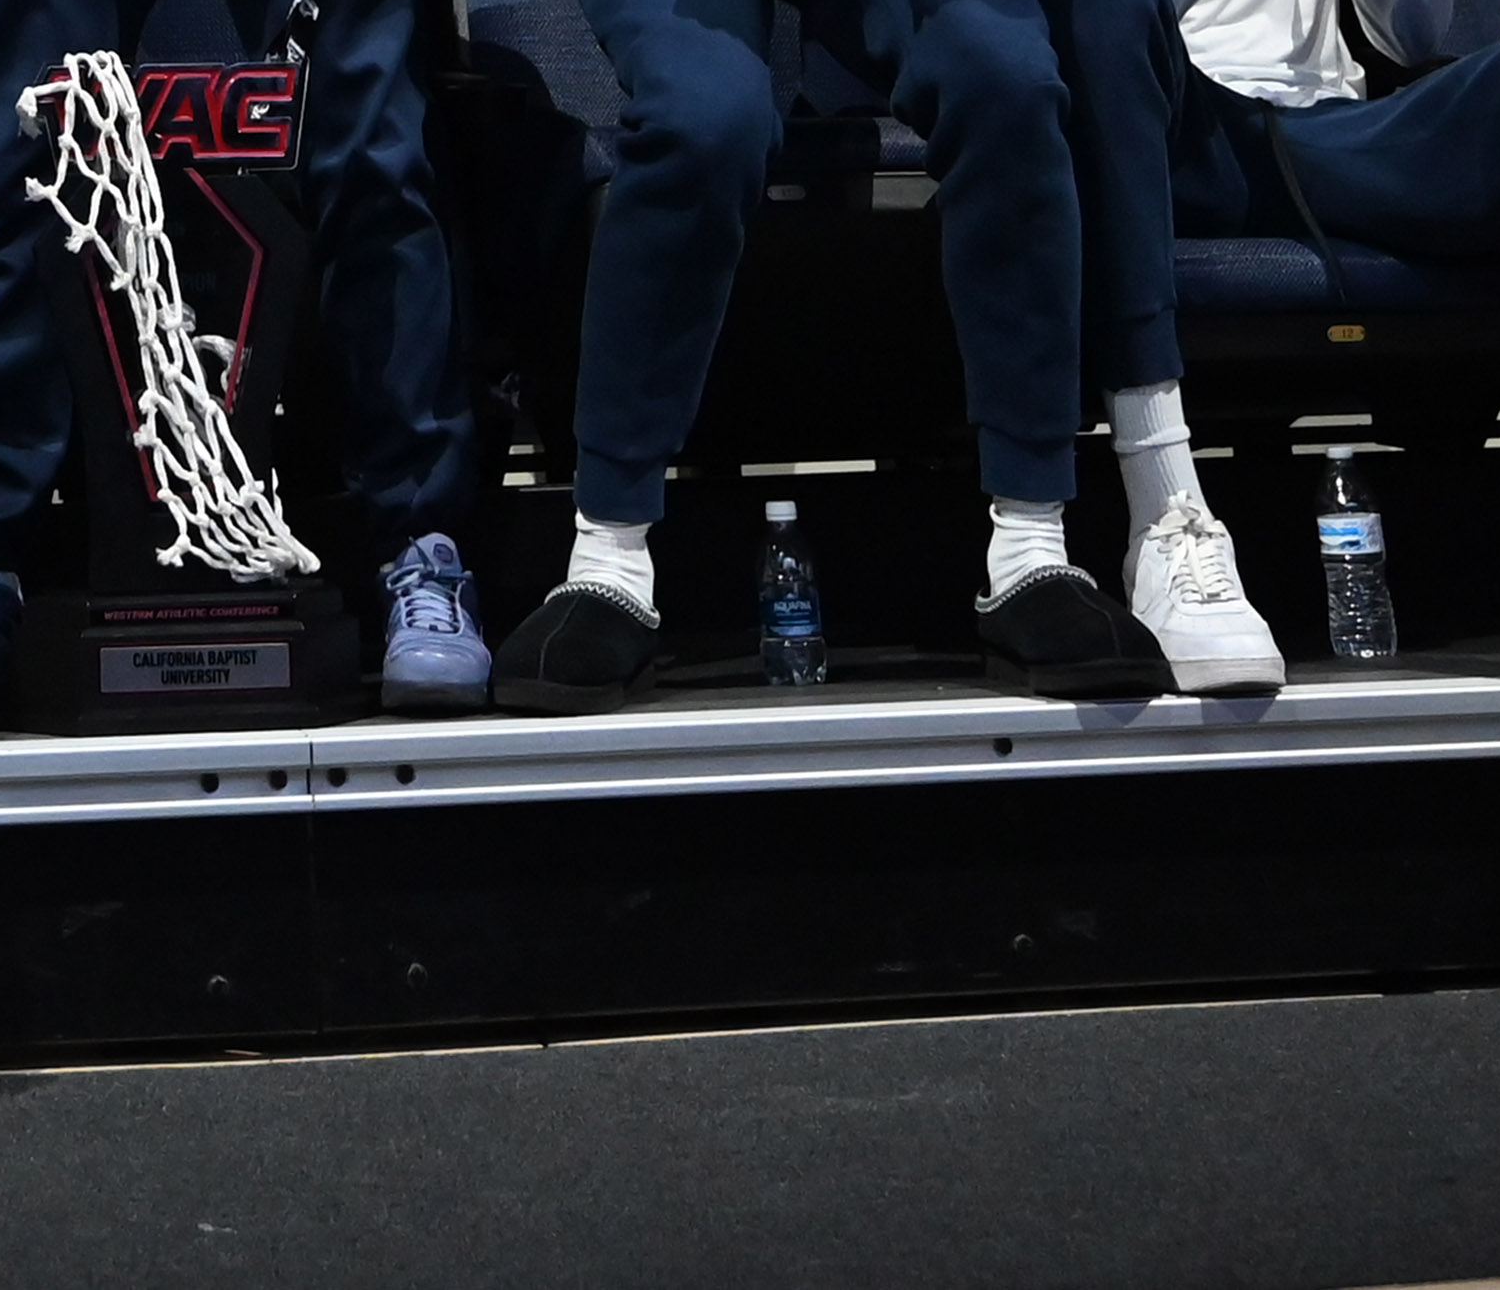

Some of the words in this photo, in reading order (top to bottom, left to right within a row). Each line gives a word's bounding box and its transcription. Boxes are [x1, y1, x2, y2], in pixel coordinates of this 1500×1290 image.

[103, 609, 153, 621] WESTERN
[154, 606, 207, 620] ATHLETIC
[208, 604, 281, 619] CONFERENCE
[133, 651, 206, 668] CALIFORNIA
[207, 649, 258, 666] BAPTIST
[160, 668, 231, 685] UNIVERSITY
